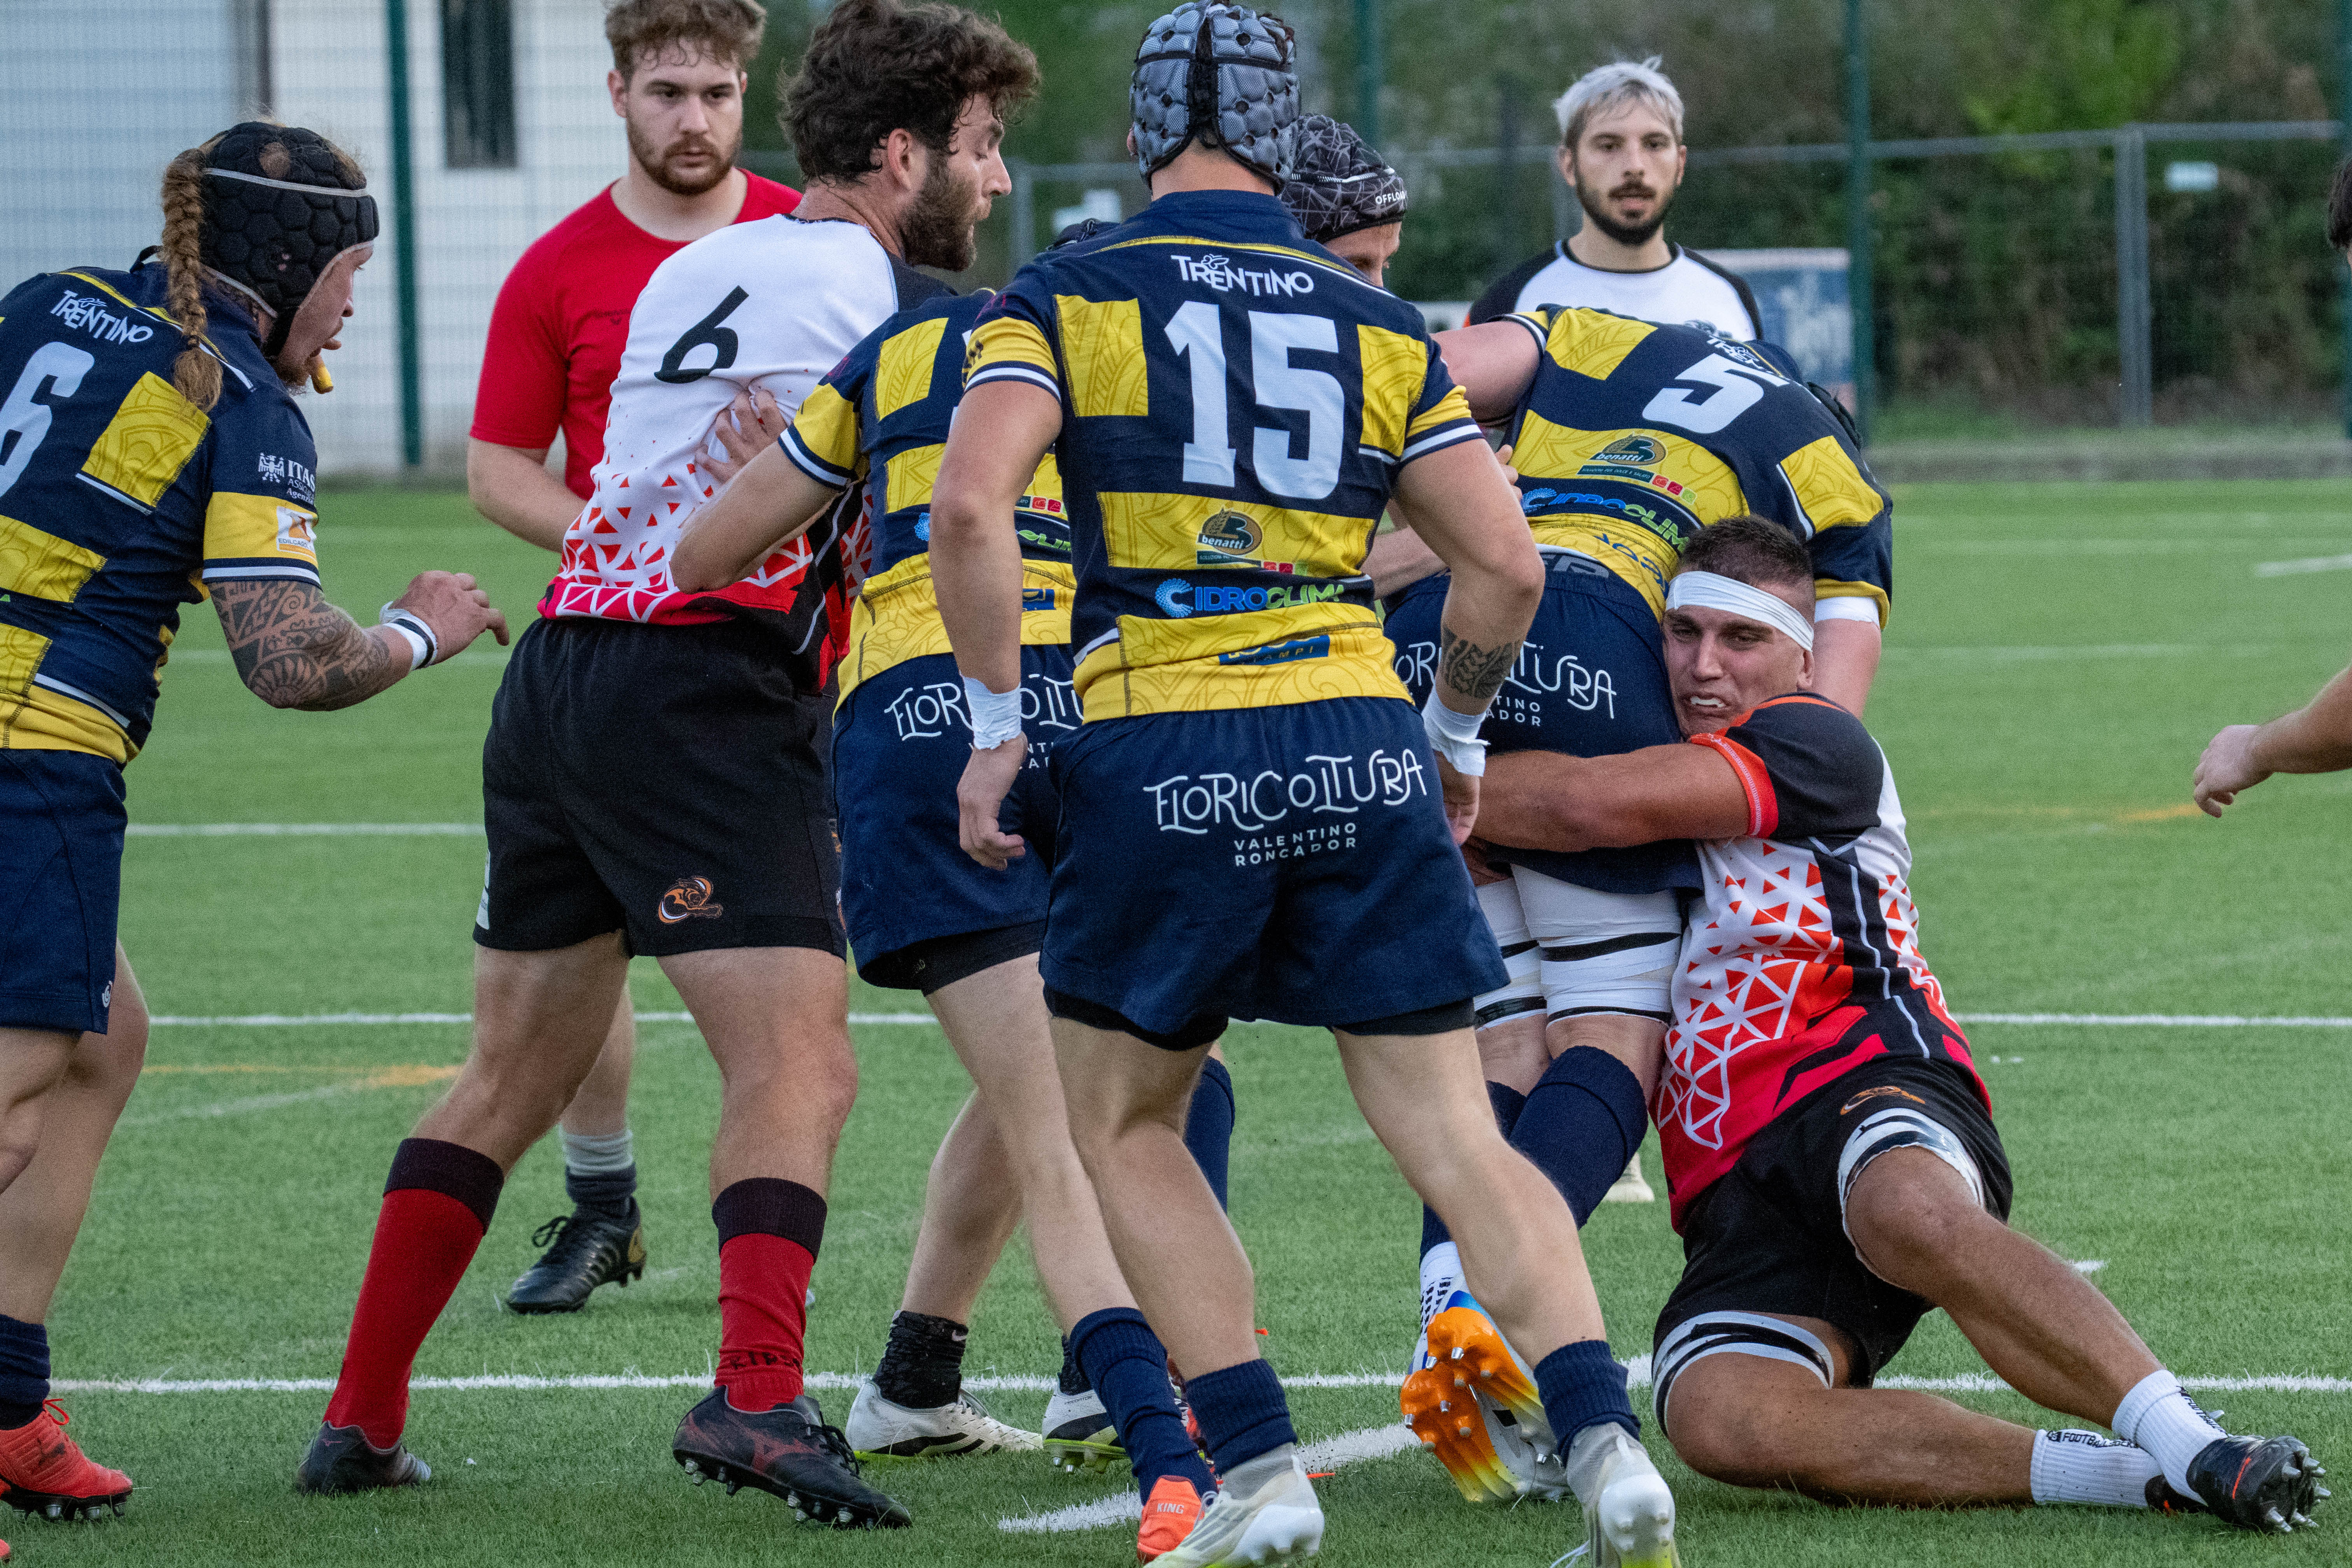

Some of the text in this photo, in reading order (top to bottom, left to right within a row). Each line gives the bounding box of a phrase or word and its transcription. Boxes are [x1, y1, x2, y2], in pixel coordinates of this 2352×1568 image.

[1171, 255, 1314, 298] TRENTINO
[50, 289, 154, 345] TRENTINO
[654, 285, 749, 384] 6
[1164, 300, 1345, 500] 15
[1642, 352, 1790, 434] 5
[0, 342, 95, 498] 6
[288, 459, 315, 492] ITAS
[1595, 453, 1644, 462] benatti
[1202, 535, 1244, 549] benatti
[1548, 493, 1690, 554] IDROCLIM
[1143, 749, 1427, 834] FLORICOLTURA
[1234, 822, 1357, 850] VALENTINO
[1235, 836, 1356, 867] RONCADOR
[1157, 1502, 1184, 1514] KING
